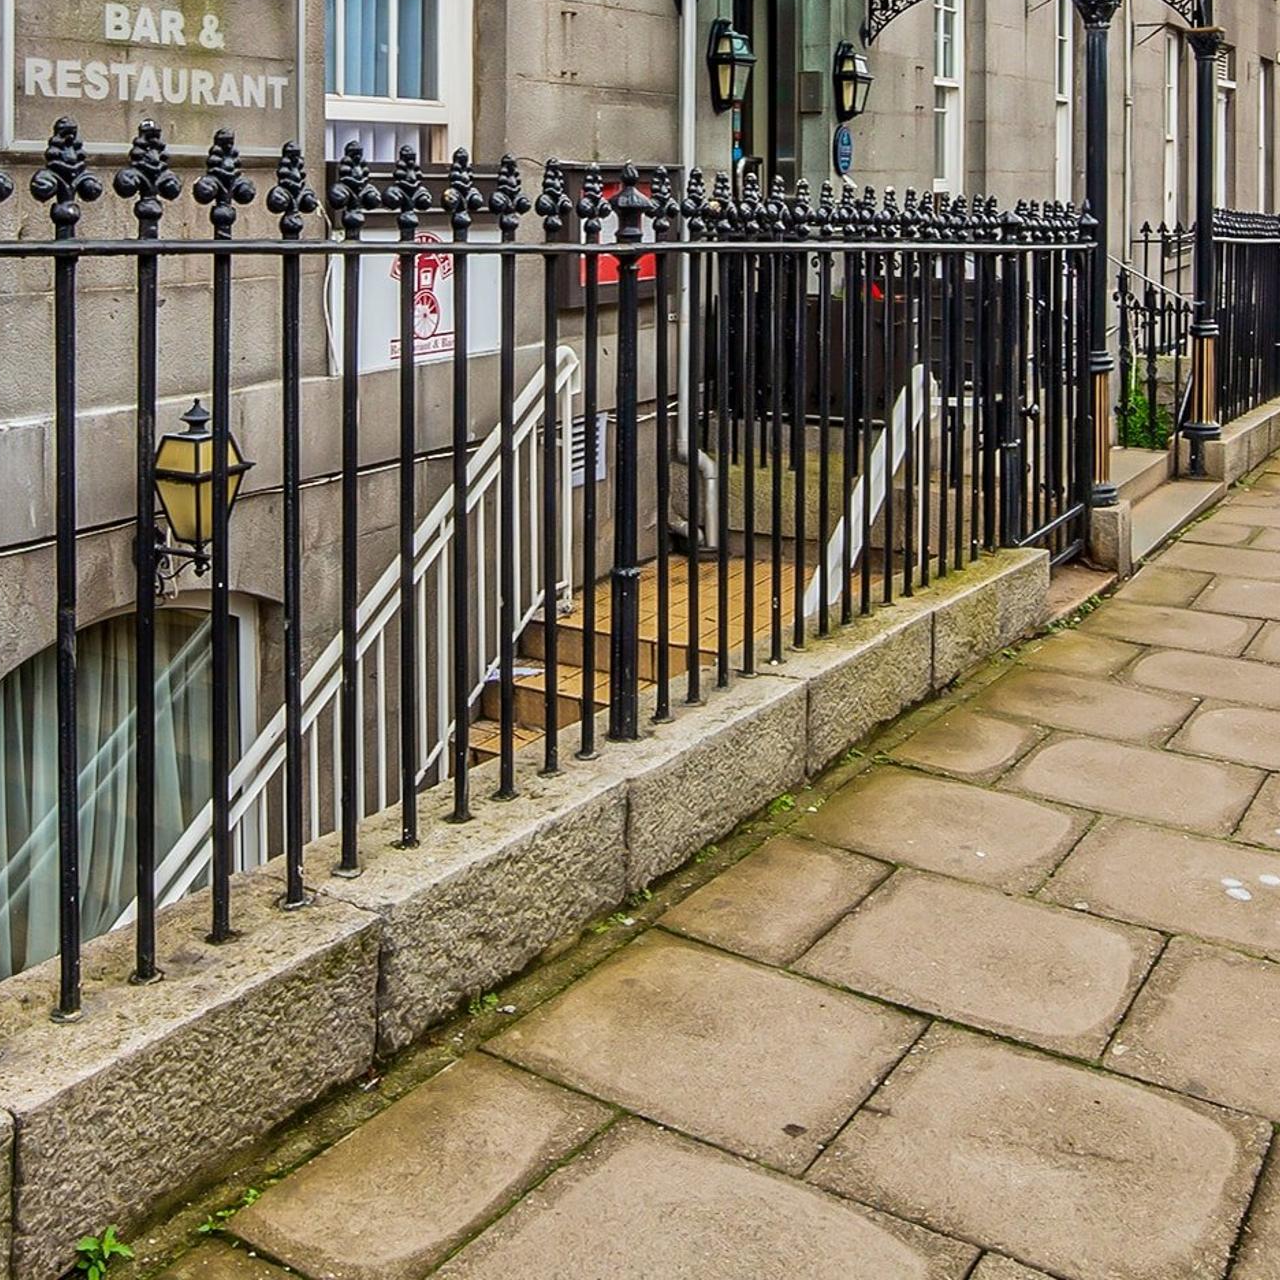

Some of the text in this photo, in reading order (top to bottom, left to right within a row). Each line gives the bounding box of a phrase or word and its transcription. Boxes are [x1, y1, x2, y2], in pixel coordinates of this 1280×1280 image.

[104, 4, 224, 48] BAR &
[25, 58, 288, 109] RESTAURANT
